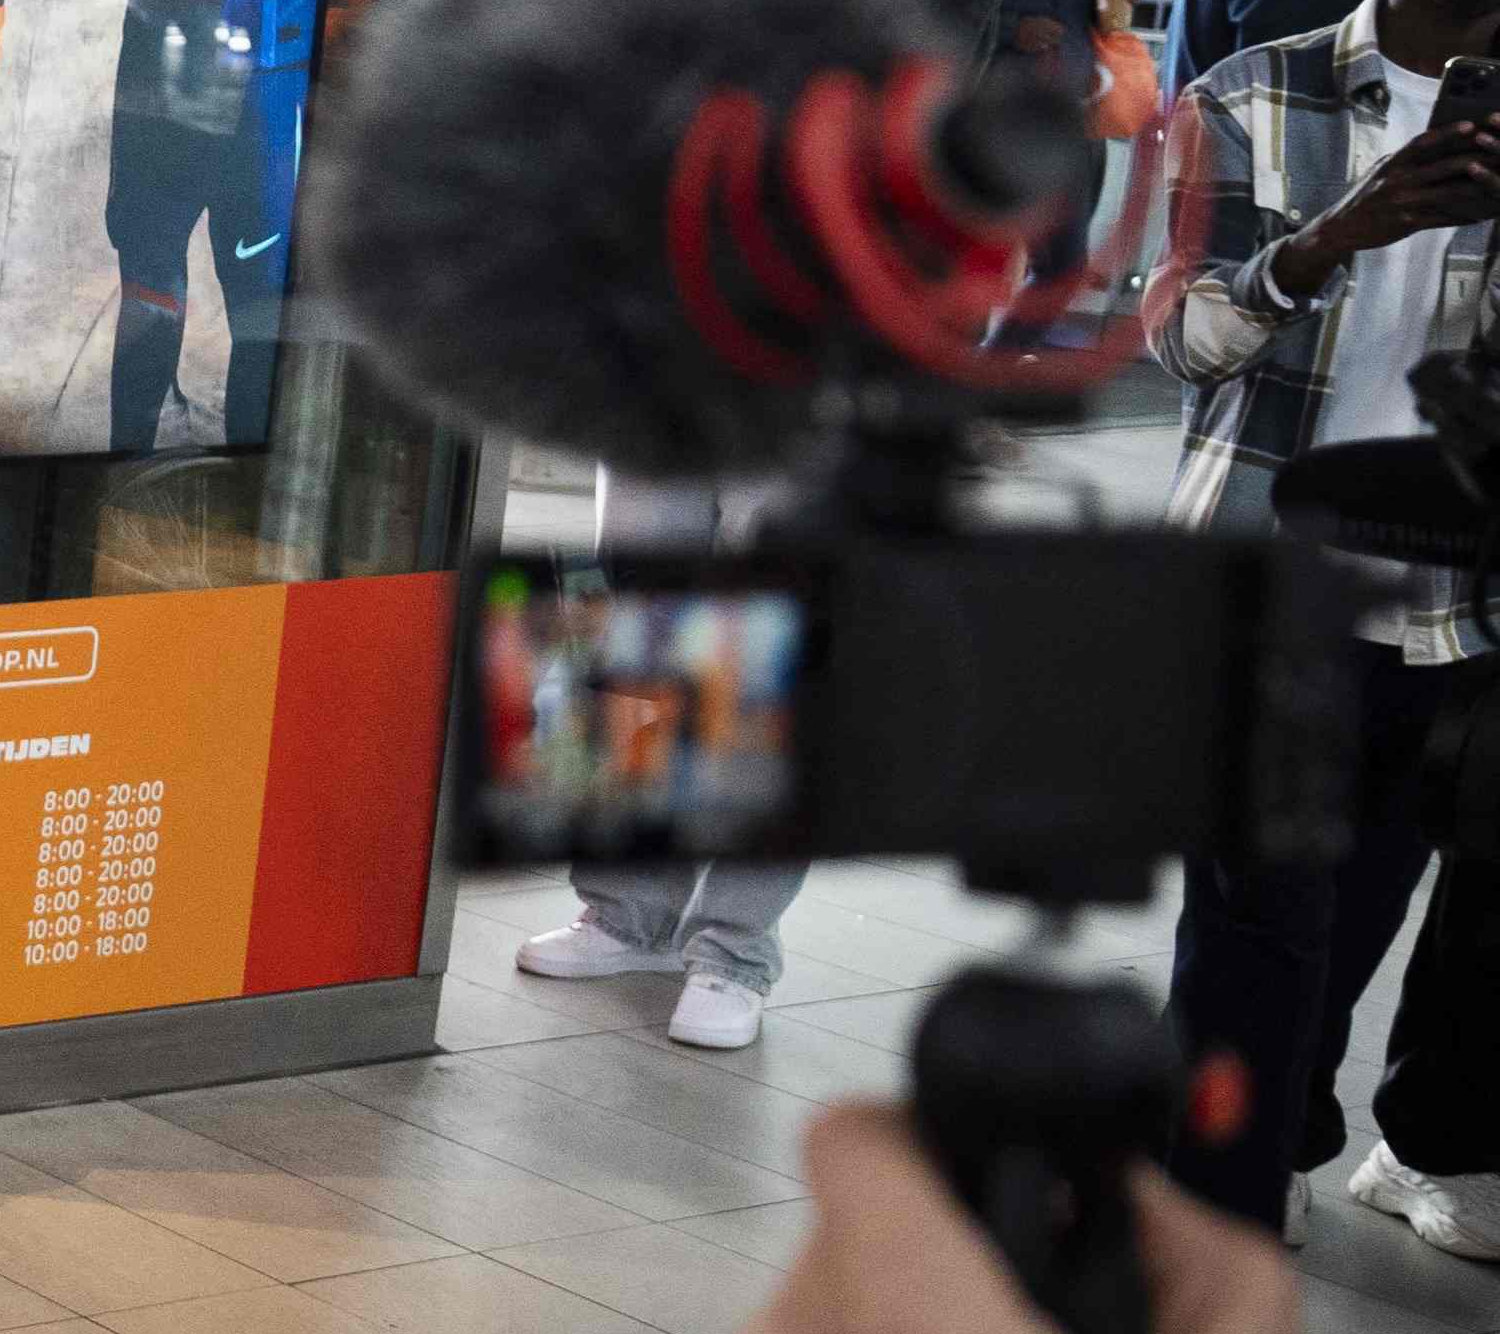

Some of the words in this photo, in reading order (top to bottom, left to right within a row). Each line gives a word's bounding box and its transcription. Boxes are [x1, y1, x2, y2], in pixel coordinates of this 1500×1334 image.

[44, 787, 90, 811] 8:00
[106, 780, 164, 807] 20:00
[41, 813, 88, 837] 8:00
[103, 806, 162, 832] 20:00
[38, 839, 85, 863] 8:00
[101, 831, 159, 857] 20:00
[36, 864, 82, 888] 8:00
[98, 856, 156, 882] 20:00
[33, 890, 80, 914] 8:00
[95, 882, 153, 907] 20:00
[27, 915, 81, 939] 10:00
[98, 907, 150, 931] 18:00
[24, 940, 78, 966] 10:00
[96, 932, 147, 957] 18:00
